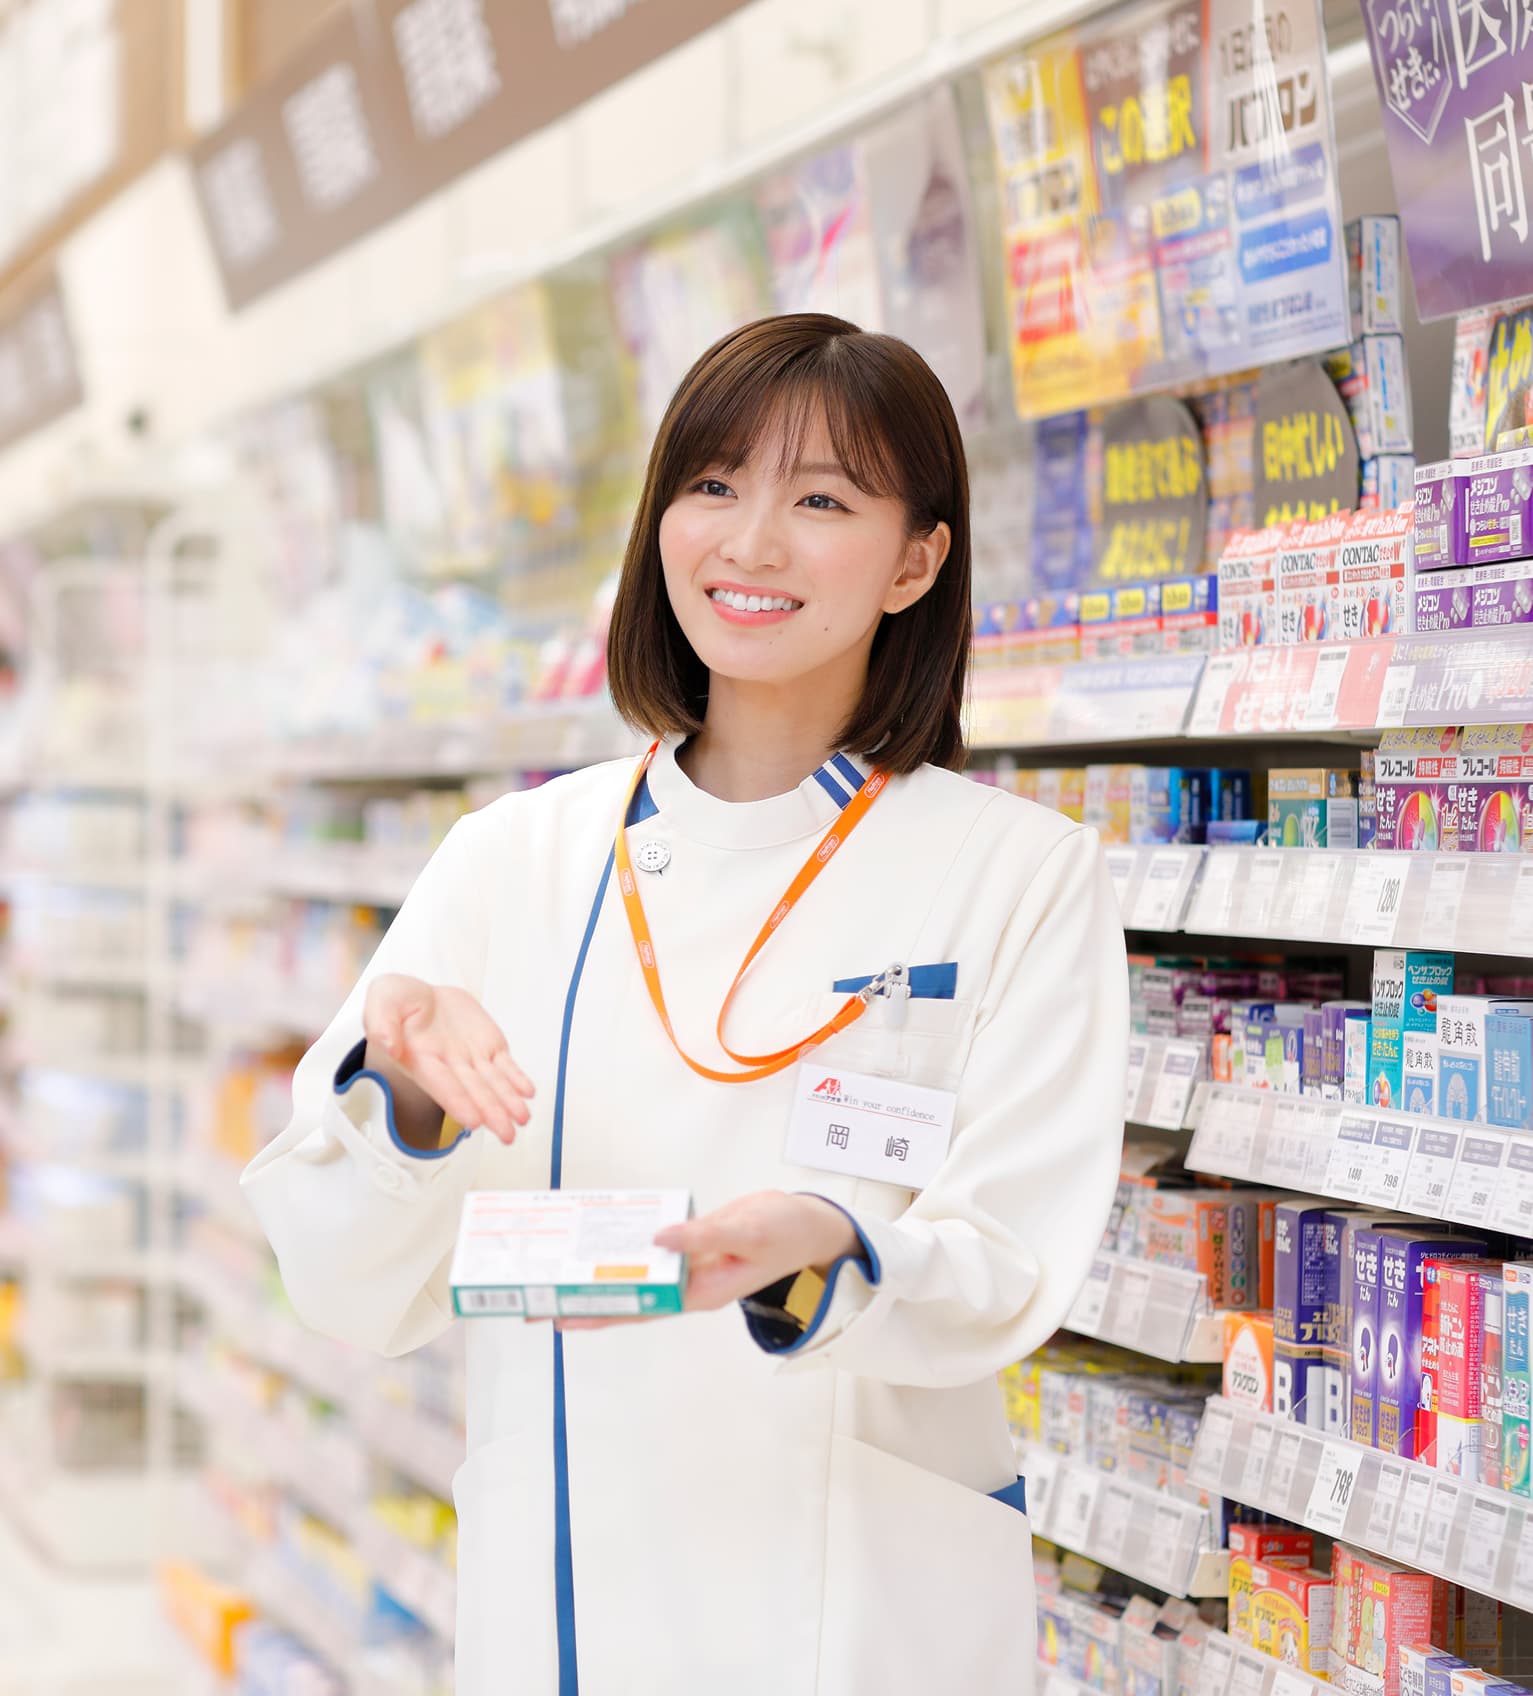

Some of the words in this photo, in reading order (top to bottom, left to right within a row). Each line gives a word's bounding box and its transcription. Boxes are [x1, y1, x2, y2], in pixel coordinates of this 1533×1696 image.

[1451, 0, 1533, 90] 医
[1464, 82, 1533, 262] 同
[1263, 412, 1345, 481] 日中忙しい
[1470, 476, 1499, 497] メジコン
[1281, 552, 1315, 572] CONTAC
[1342, 543, 1379, 566] CONTAC
[1417, 593, 1440, 612] メジコン
[1474, 587, 1500, 606] メジコン
[1281, 609, 1296, 633] せき
[1343, 604, 1358, 628] せき
[1380, 758, 1415, 777] プレコール
[1463, 757, 1496, 777] プレコール
[1376, 787, 1396, 812] せき
[1458, 787, 1478, 813] せき
[1379, 814, 1397, 830] たんに
[1461, 814, 1478, 831] たんに
[1441, 1017, 1478, 1047] 龍角散
[843, 1094, 857, 1106] Win
[863, 1101, 883, 1112] your
[886, 1104, 936, 1122] confidence
[826, 1123, 850, 1150] 岡
[885, 1135, 911, 1162] 崎
[1383, 1174, 1399, 1188] 798
[1355, 1251, 1378, 1282] せき
[1383, 1256, 1406, 1288] せき
[1360, 1286, 1371, 1302] たん
[1387, 1292, 1398, 1307] たん
[1329, 1467, 1353, 1505] 798
